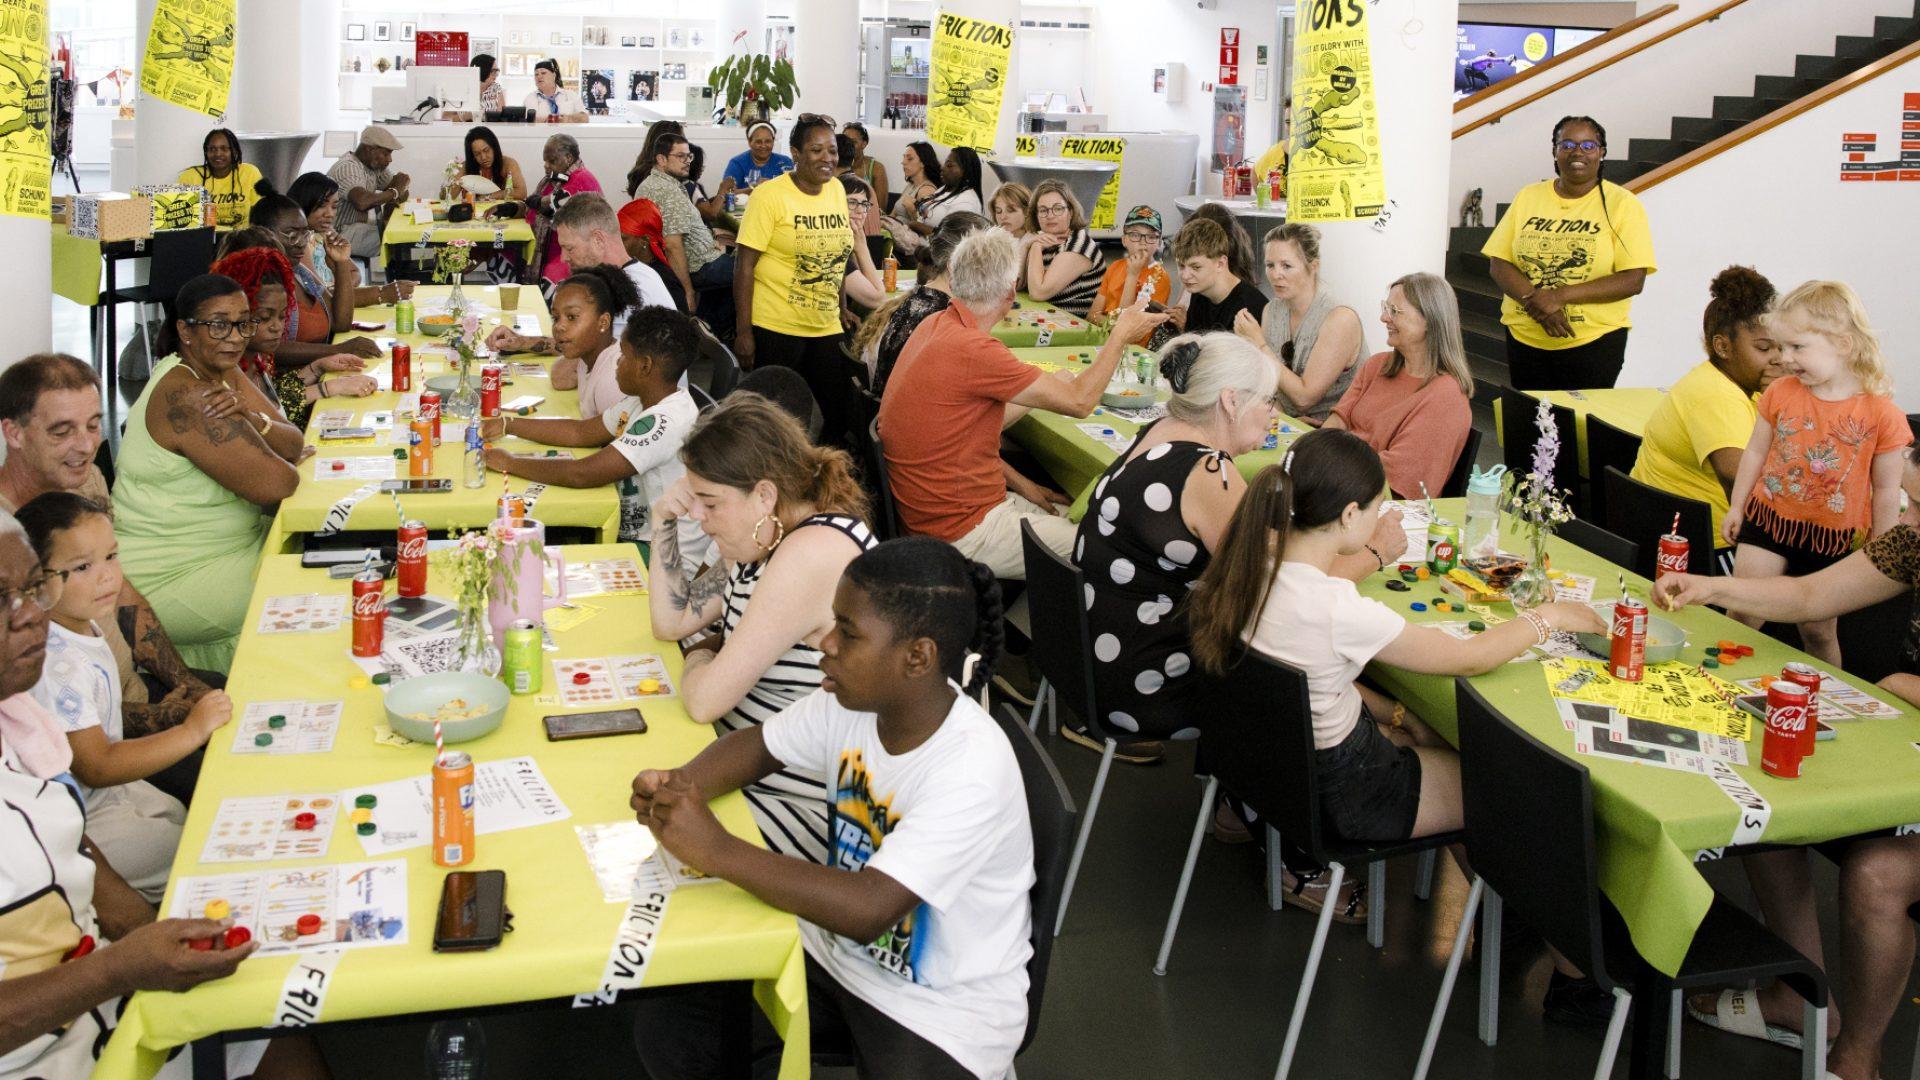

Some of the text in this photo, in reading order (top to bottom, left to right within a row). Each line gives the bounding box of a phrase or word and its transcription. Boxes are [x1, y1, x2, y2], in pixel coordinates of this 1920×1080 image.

[938, 14, 1011, 49] FRICTIONS
[1320, 41, 1342, 51] GLORY
[1343, 39, 1364, 49] WITH
[1062, 139, 1123, 155] FRICTIONS
[1300, 198, 1331, 207] SCHUNCK
[1522, 217, 1601, 235] FRICTIONS
[512, 760, 561, 816] FRICTIONS
